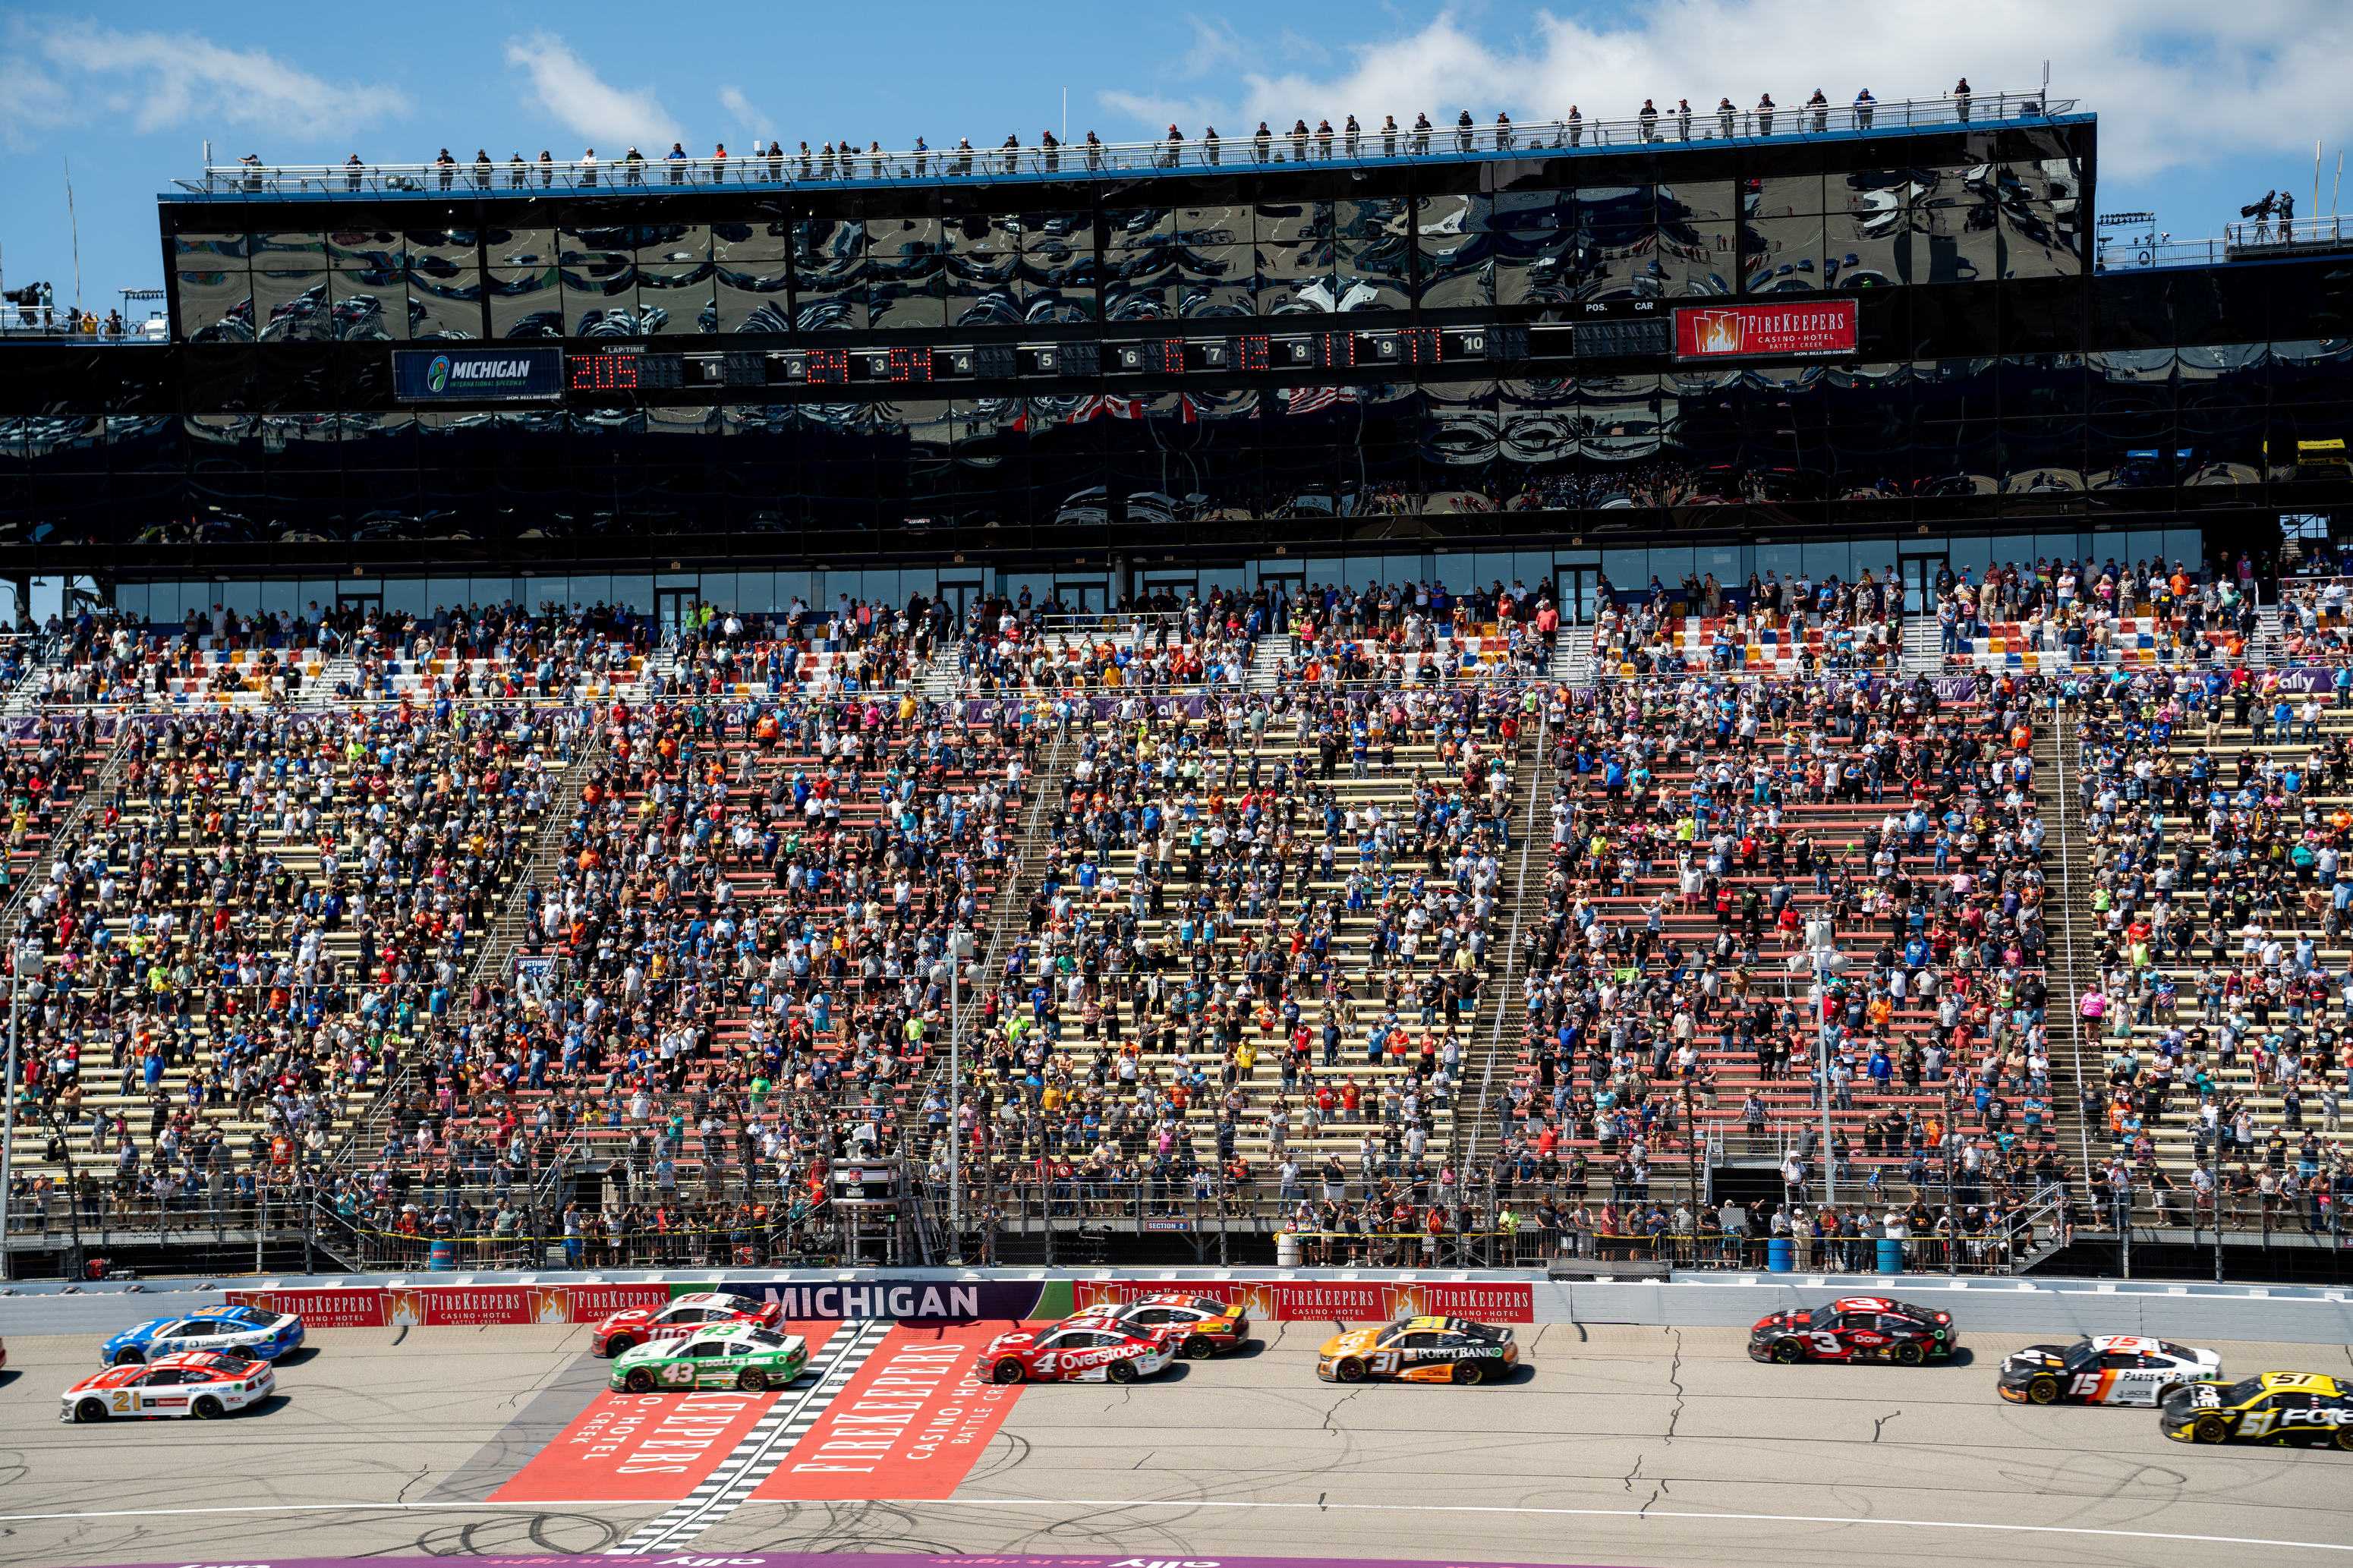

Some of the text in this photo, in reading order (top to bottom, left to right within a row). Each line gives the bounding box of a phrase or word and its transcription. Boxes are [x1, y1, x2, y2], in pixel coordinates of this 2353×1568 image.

[1586, 302, 1654, 312] POS. CAR
[1463, 336, 1483, 351] 10
[1758, 333, 1835, 344] CASINO HOTEL
[1240, 336, 1269, 370] 12
[1295, 345, 1306, 358] 8
[1381, 340, 1393, 354] 9
[1042, 354, 1052, 367] 5
[1126, 351, 1136, 364] 6
[1210, 348, 1221, 361] 7
[451, 360, 531, 379] MICHIGAN
[708, 363, 717, 376] 1
[790, 361, 801, 374] 2
[806, 349, 848, 383] 24
[874, 359, 885, 372] 3
[890, 348, 931, 381] 54
[957, 356, 969, 369] 4
[572, 355, 637, 389] 205
[2278, 672, 2314, 692] ally
[764, 1286, 978, 1318] MICHIGAN
[1140, 1294, 1182, 1304] 34
[1841, 1297, 1885, 1310] 3
[335, 1314, 364, 1322] HOTEL
[1407, 1316, 1447, 1330] 31
[647, 1327, 676, 1343] 10
[698, 1325, 742, 1337] 43
[152, 1340, 185, 1357] 41
[1810, 1331, 1842, 1353] 3
[2109, 1337, 2142, 1346] 15
[151, 1352, 206, 1366] 21
[1060, 1343, 1147, 1371] Overstock
[1418, 1347, 1495, 1359] POPPY BANK
[705, 1356, 774, 1367] DOLLAR TREE
[1032, 1351, 1059, 1374] 4
[1370, 1352, 1403, 1374] 31
[662, 1362, 695, 1383] 43
[2123, 1371, 2155, 1381] PARTS
[2276, 1374, 2315, 1385] 51
[2068, 1374, 2103, 1394] 15
[113, 1390, 141, 1412] 21
[569, 1412, 615, 1444] CREEK
[951, 1407, 993, 1444] BATTLE
[2238, 1413, 2276, 1436] 51
[582, 1416, 646, 1459] HOTEL
[906, 1407, 962, 1460] CASINO
[653, 1556, 766, 1566] ally
